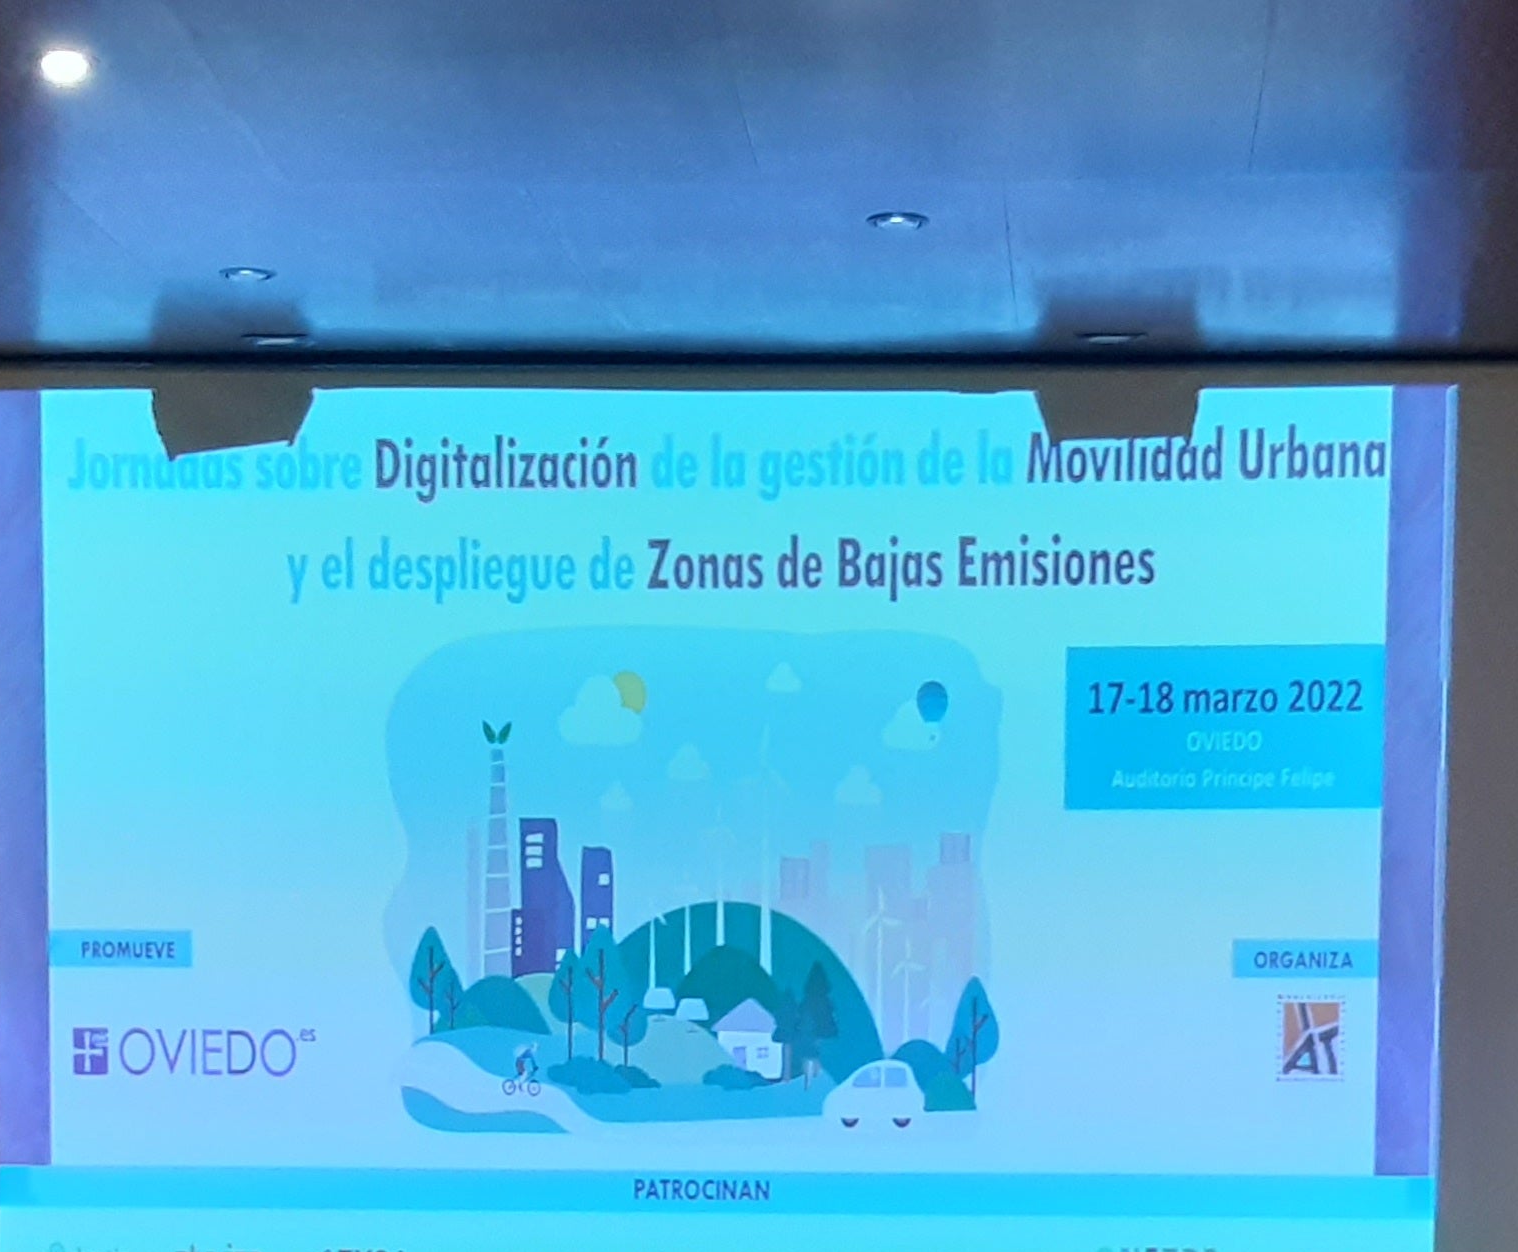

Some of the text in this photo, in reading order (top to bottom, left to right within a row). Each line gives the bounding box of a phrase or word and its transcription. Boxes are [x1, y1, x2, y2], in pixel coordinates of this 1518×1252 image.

[68, 424, 1386, 503] Jornadas sobre Digitalización de la gestión de la Movilidad Urbana
[287, 533, 1156, 603] y el despliegue de Zonas de Bajas Emisiones
[1088, 679, 1364, 714] 17-18 marzo 2022
[1186, 730, 1263, 752] OVIEDO
[1111, 768, 1196, 788] Auditorio
[1281, 767, 1336, 788] Felipe
[81, 941, 176, 960] PROMUEVE
[1253, 950, 1354, 970] ORGANIZA
[119, 1027, 296, 1078] OVIEDO
[634, 1178, 771, 1201] PATROCINAN
